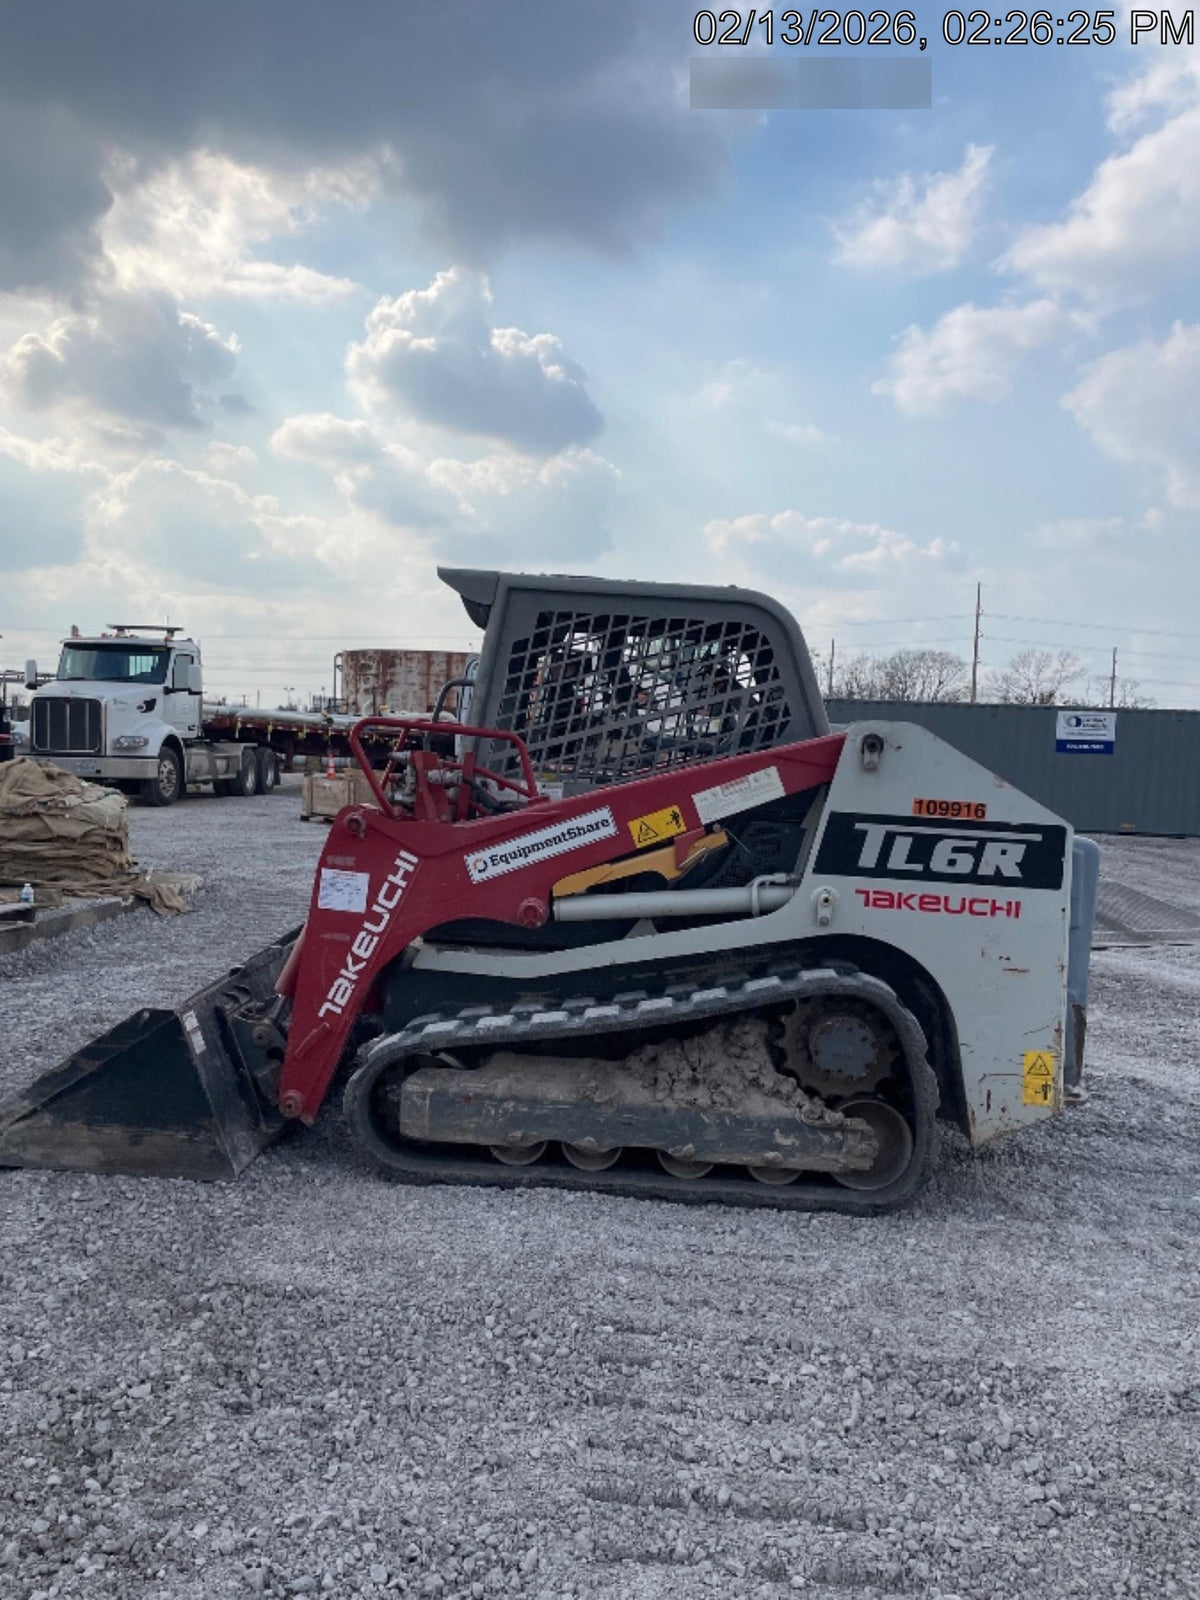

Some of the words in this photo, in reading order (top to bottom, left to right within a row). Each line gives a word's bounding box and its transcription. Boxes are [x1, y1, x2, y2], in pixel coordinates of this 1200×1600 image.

[914, 799, 986, 819] 109916
[489, 818, 610, 866] EquipmentShare
[854, 822, 1042, 878] TL6R
